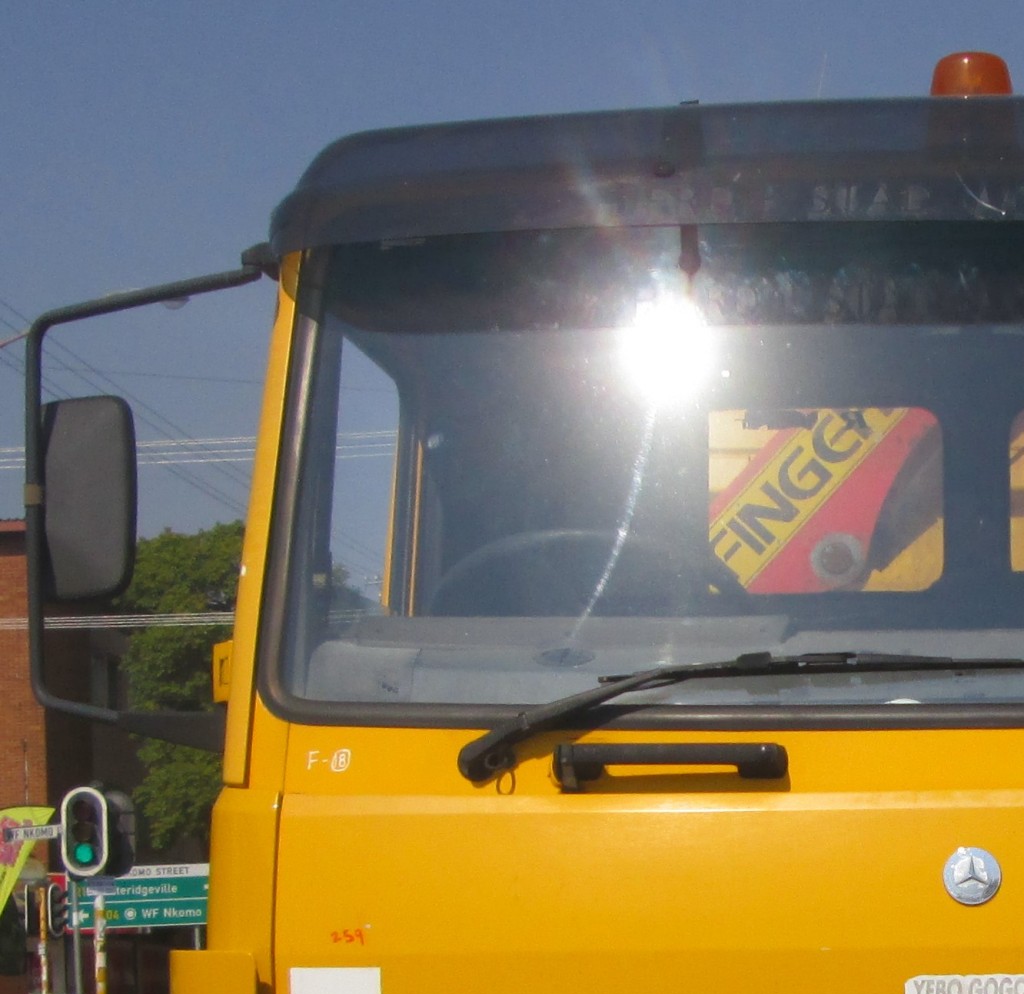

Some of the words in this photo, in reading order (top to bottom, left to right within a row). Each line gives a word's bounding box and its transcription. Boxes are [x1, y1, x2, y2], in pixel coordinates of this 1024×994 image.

[156, 867, 190, 875] STREET
[116, 884, 178, 896] teridgeville
[142, 908, 159, 918] WF
[163, 907, 202, 918] Nkomo
